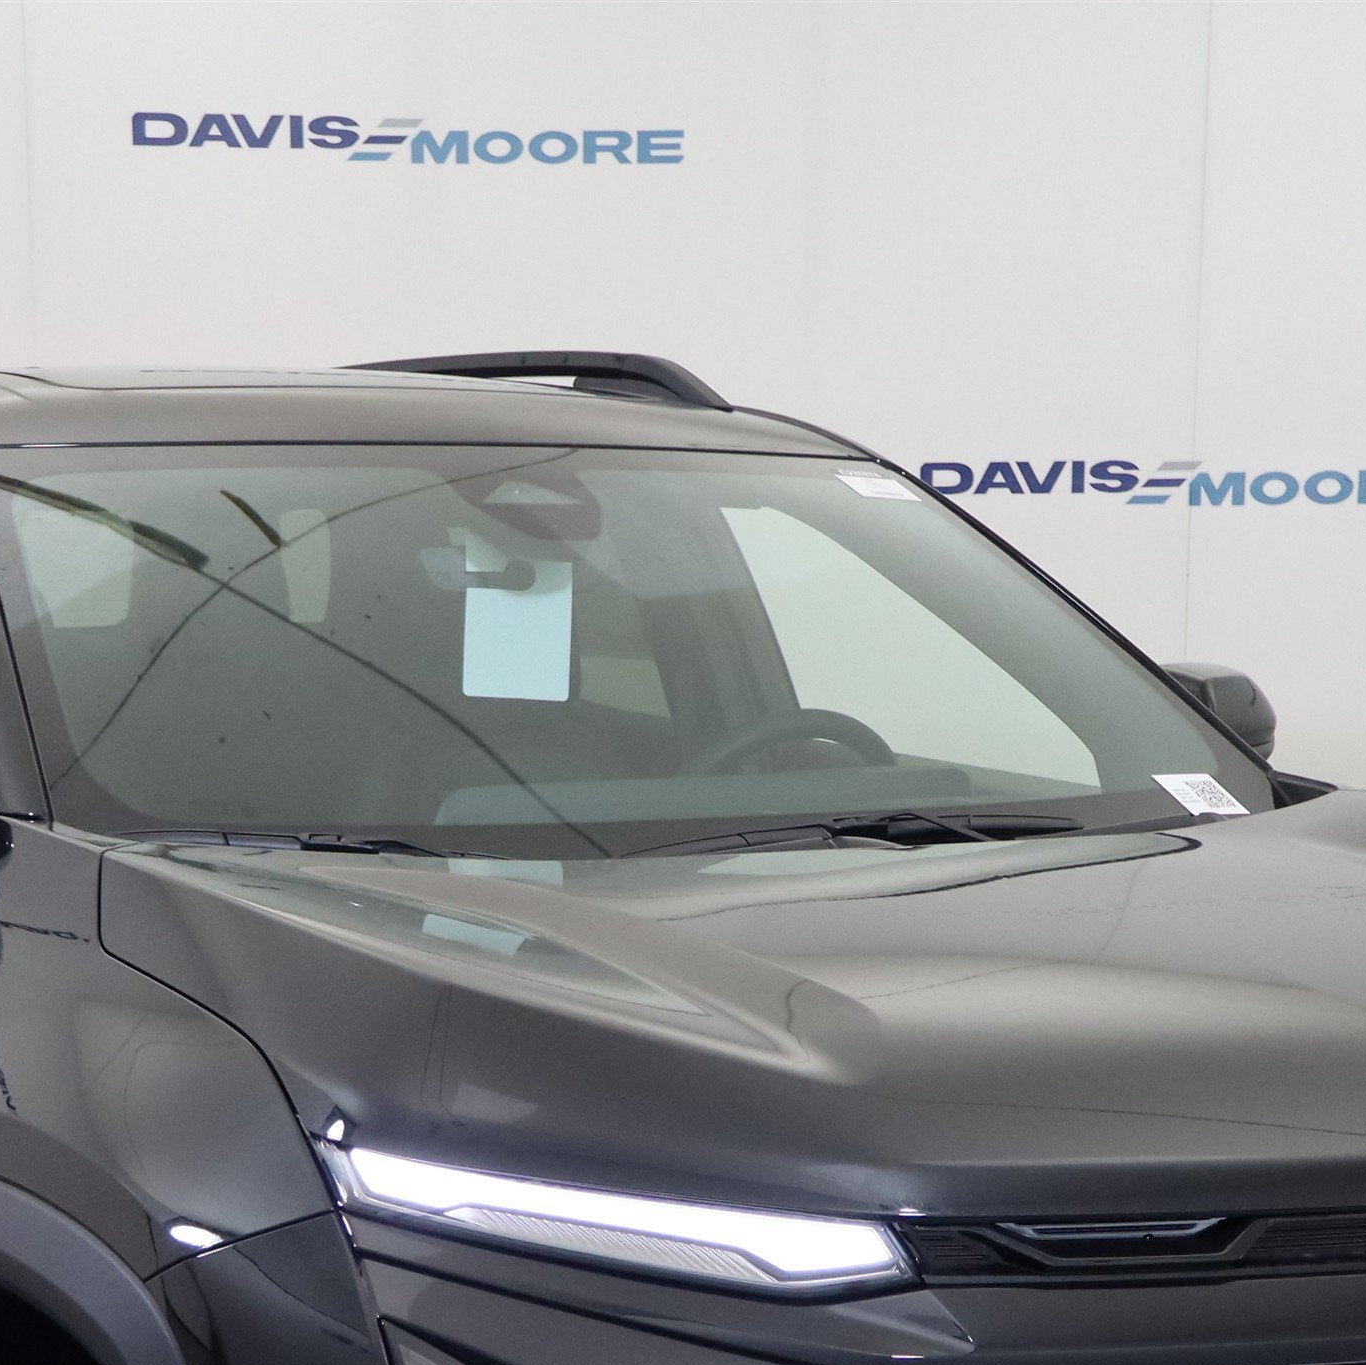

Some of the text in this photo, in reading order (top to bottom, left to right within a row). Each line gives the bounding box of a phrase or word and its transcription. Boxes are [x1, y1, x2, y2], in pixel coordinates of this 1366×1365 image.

[132, 112, 684, 164] DAVIS MOORE
[920, 460, 1139, 495] DAVIS
